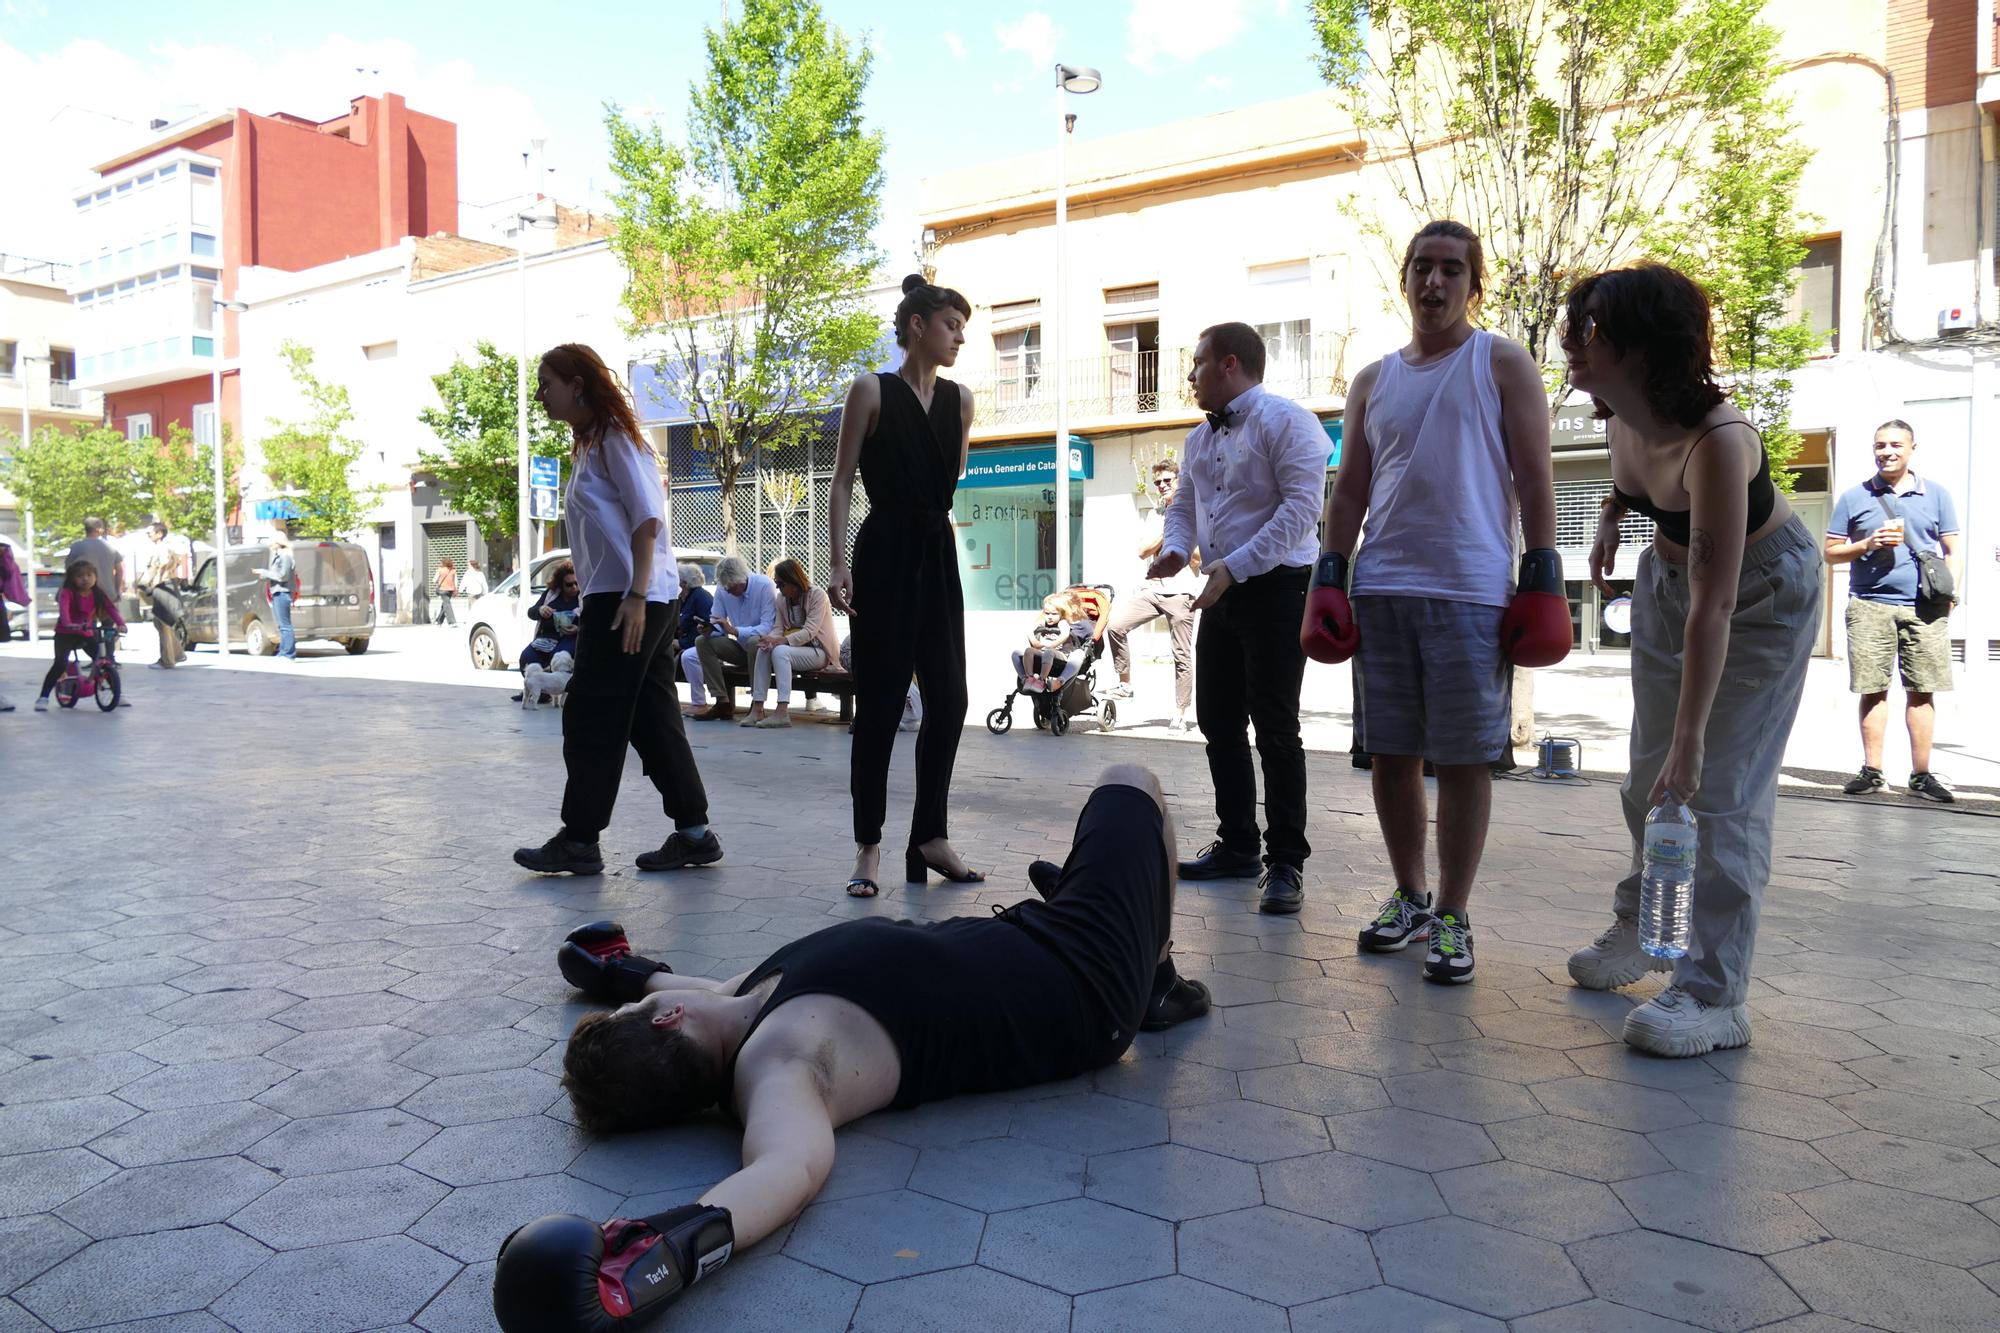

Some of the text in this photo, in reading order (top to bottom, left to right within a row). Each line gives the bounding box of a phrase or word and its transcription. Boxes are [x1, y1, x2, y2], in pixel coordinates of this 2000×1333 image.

[968, 461, 1056, 475] MÚTUA General de Cata
